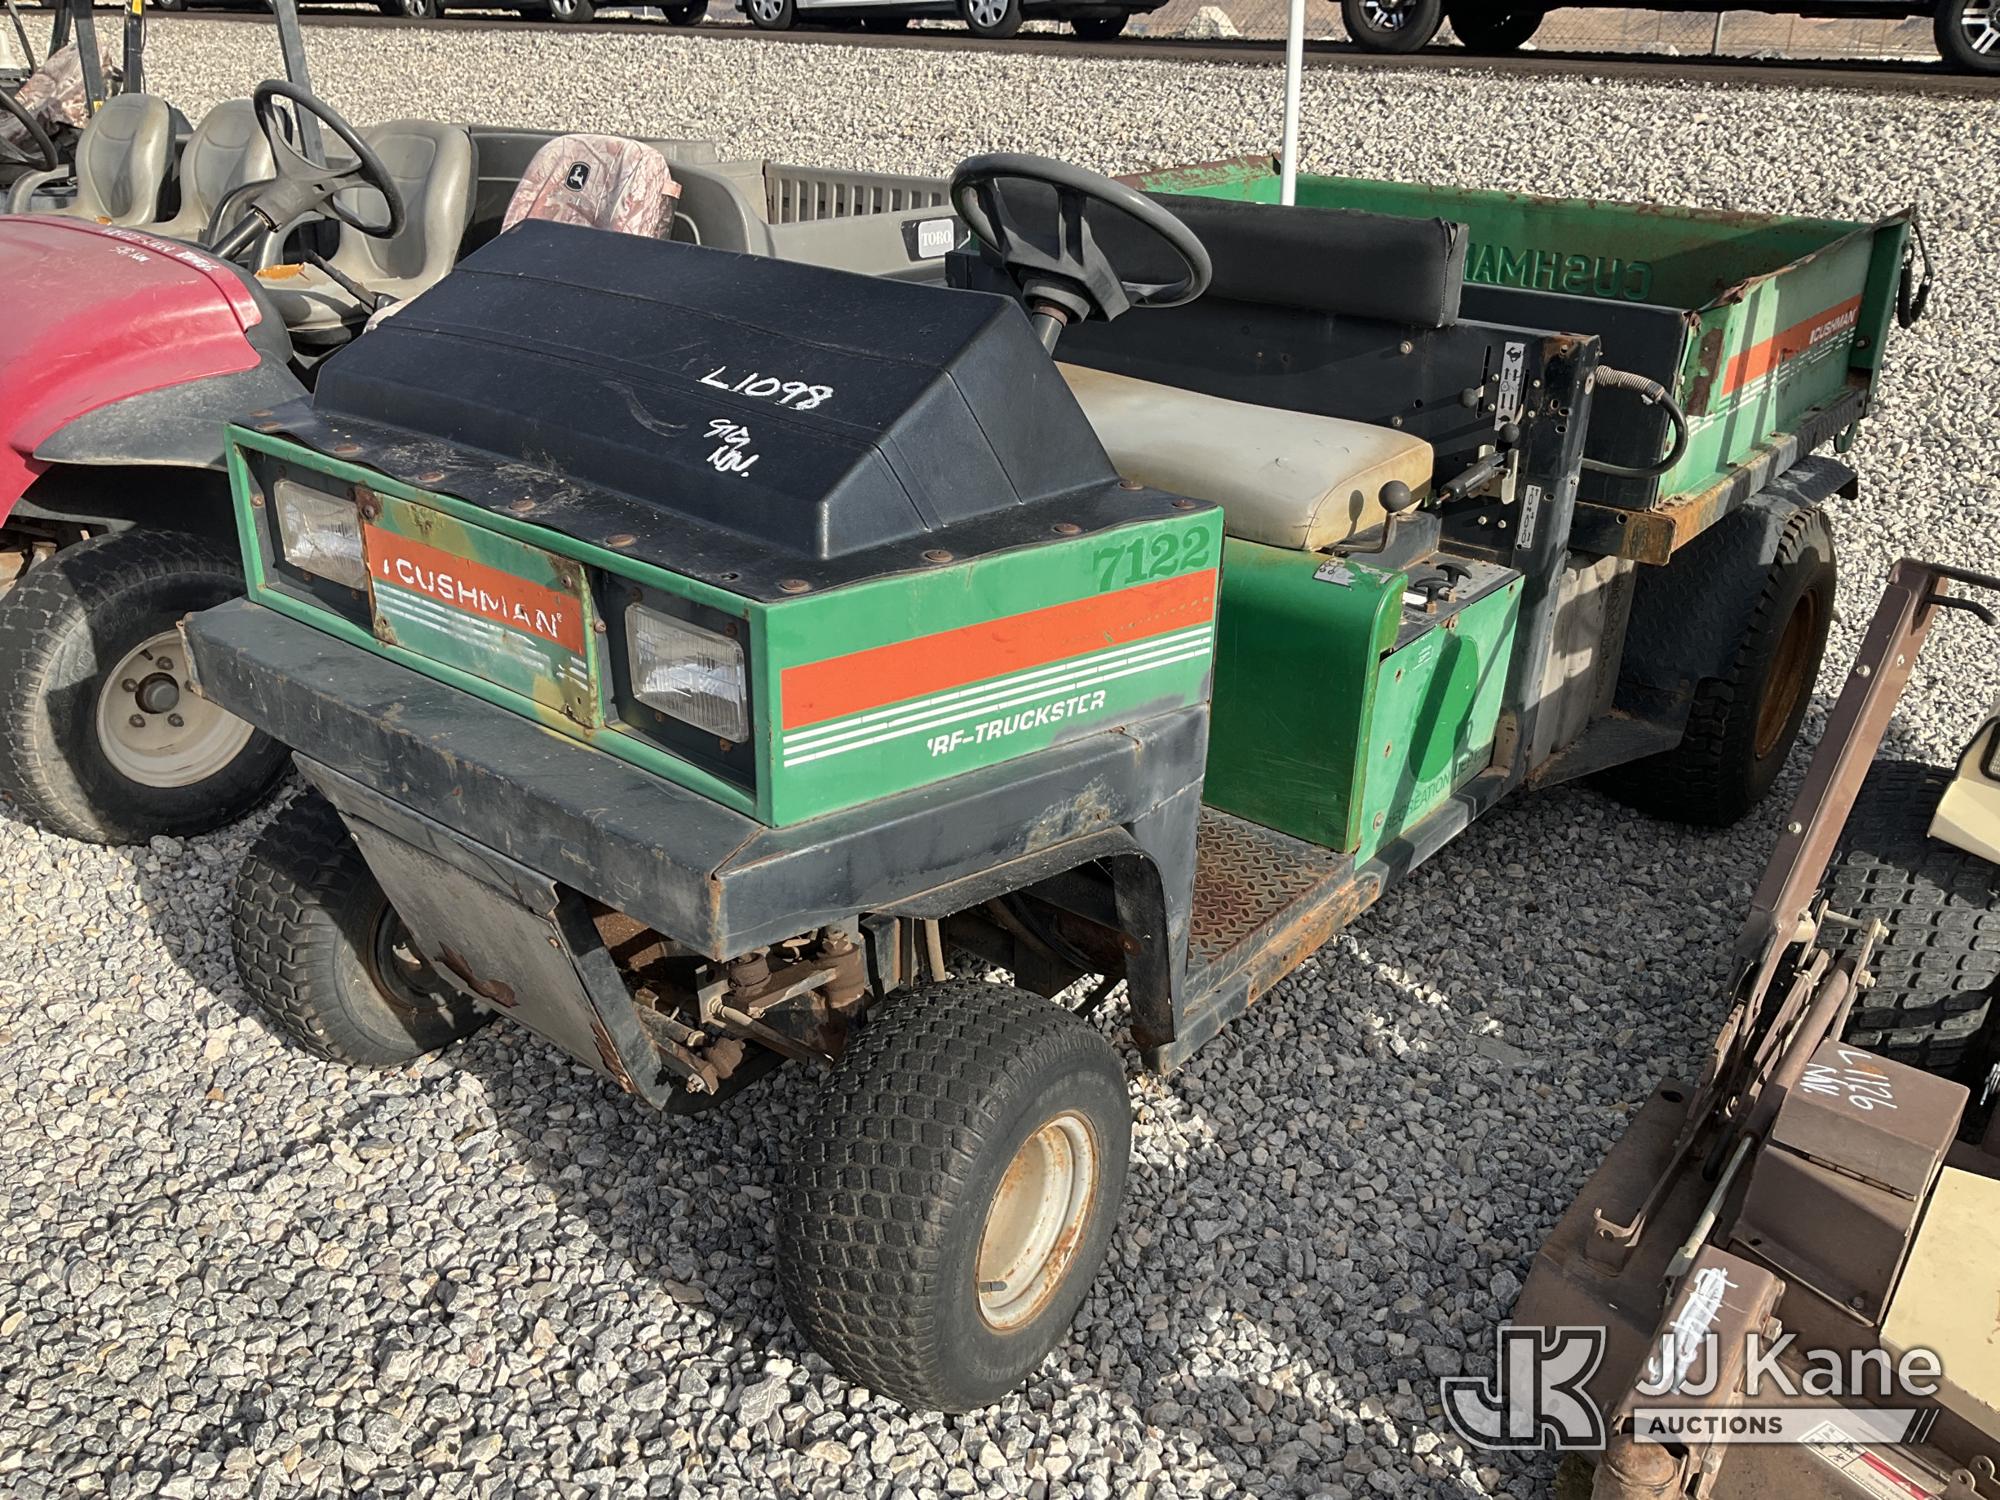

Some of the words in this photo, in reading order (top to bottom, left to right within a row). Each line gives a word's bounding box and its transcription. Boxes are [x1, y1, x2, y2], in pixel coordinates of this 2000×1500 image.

[921, 229, 952, 247] TORO
[1813, 308, 1857, 343] CUSHMAN
[696, 365, 834, 410] L1098
[1092, 525, 1210, 593] 7122
[1837, 1049, 1898, 1110] L1126
